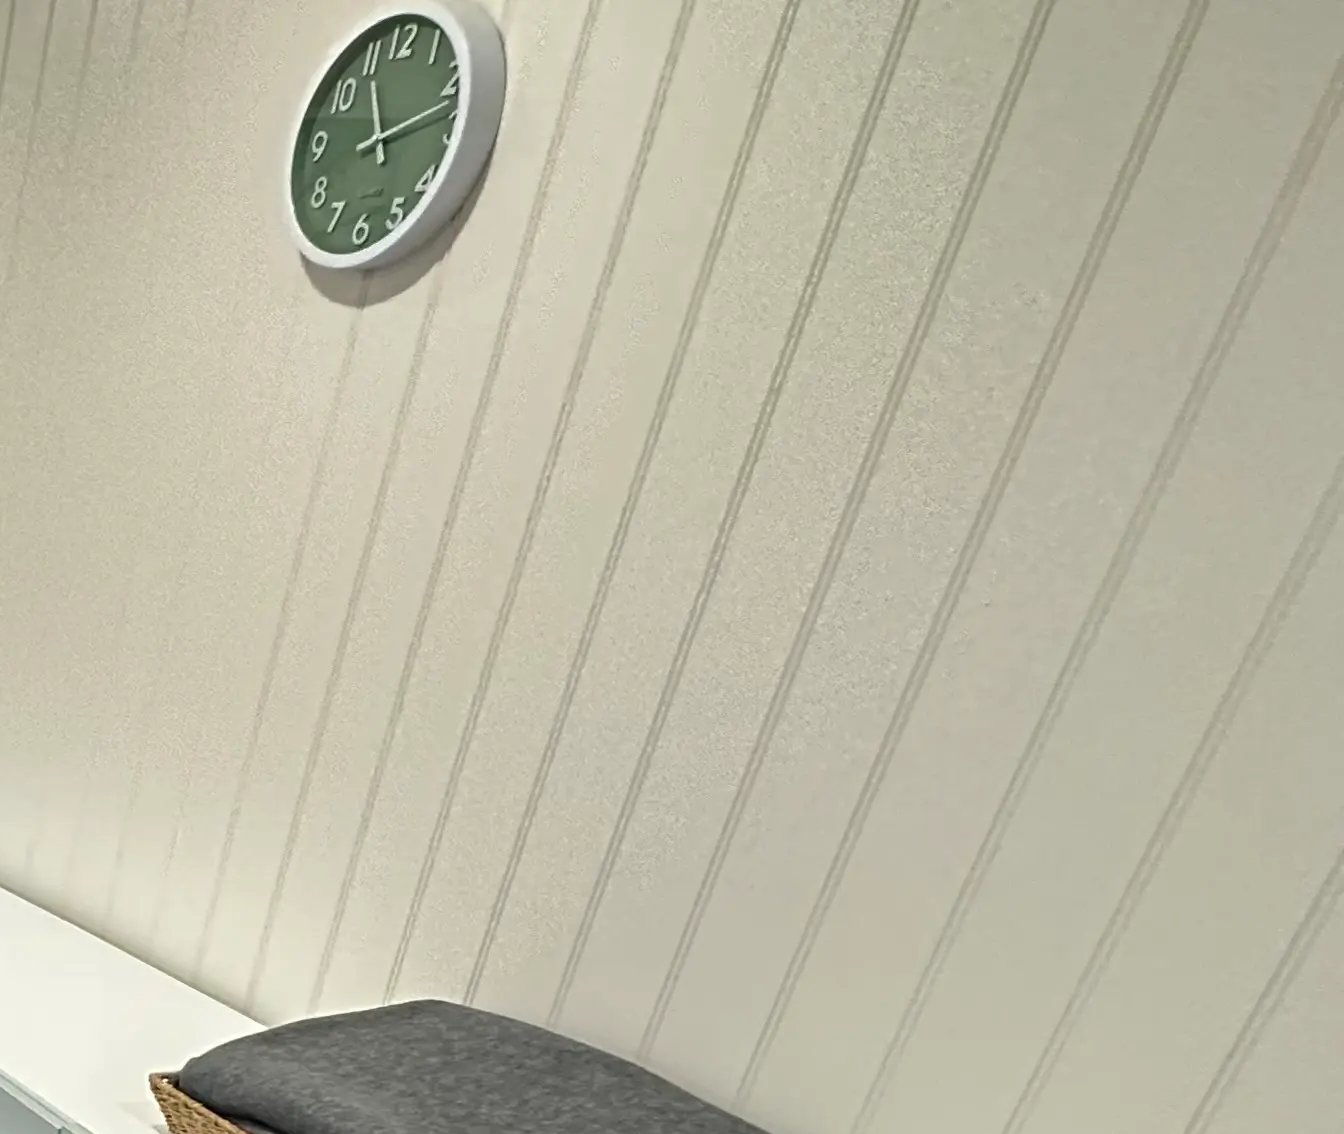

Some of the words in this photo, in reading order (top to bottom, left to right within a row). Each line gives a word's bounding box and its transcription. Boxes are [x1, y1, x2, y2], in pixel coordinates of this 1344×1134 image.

[362, 40, 381, 76] 11
[388, 23, 418, 60] 12
[428, 29, 441, 65] 1
[440, 60, 459, 97] 2
[331, 77, 356, 114] 10
[312, 131, 328, 162] 9
[311, 176, 327, 208] 8
[414, 164, 436, 192] 4
[327, 200, 346, 233] 7
[352, 213, 369, 245] 6
[385, 197, 405, 230] 5
